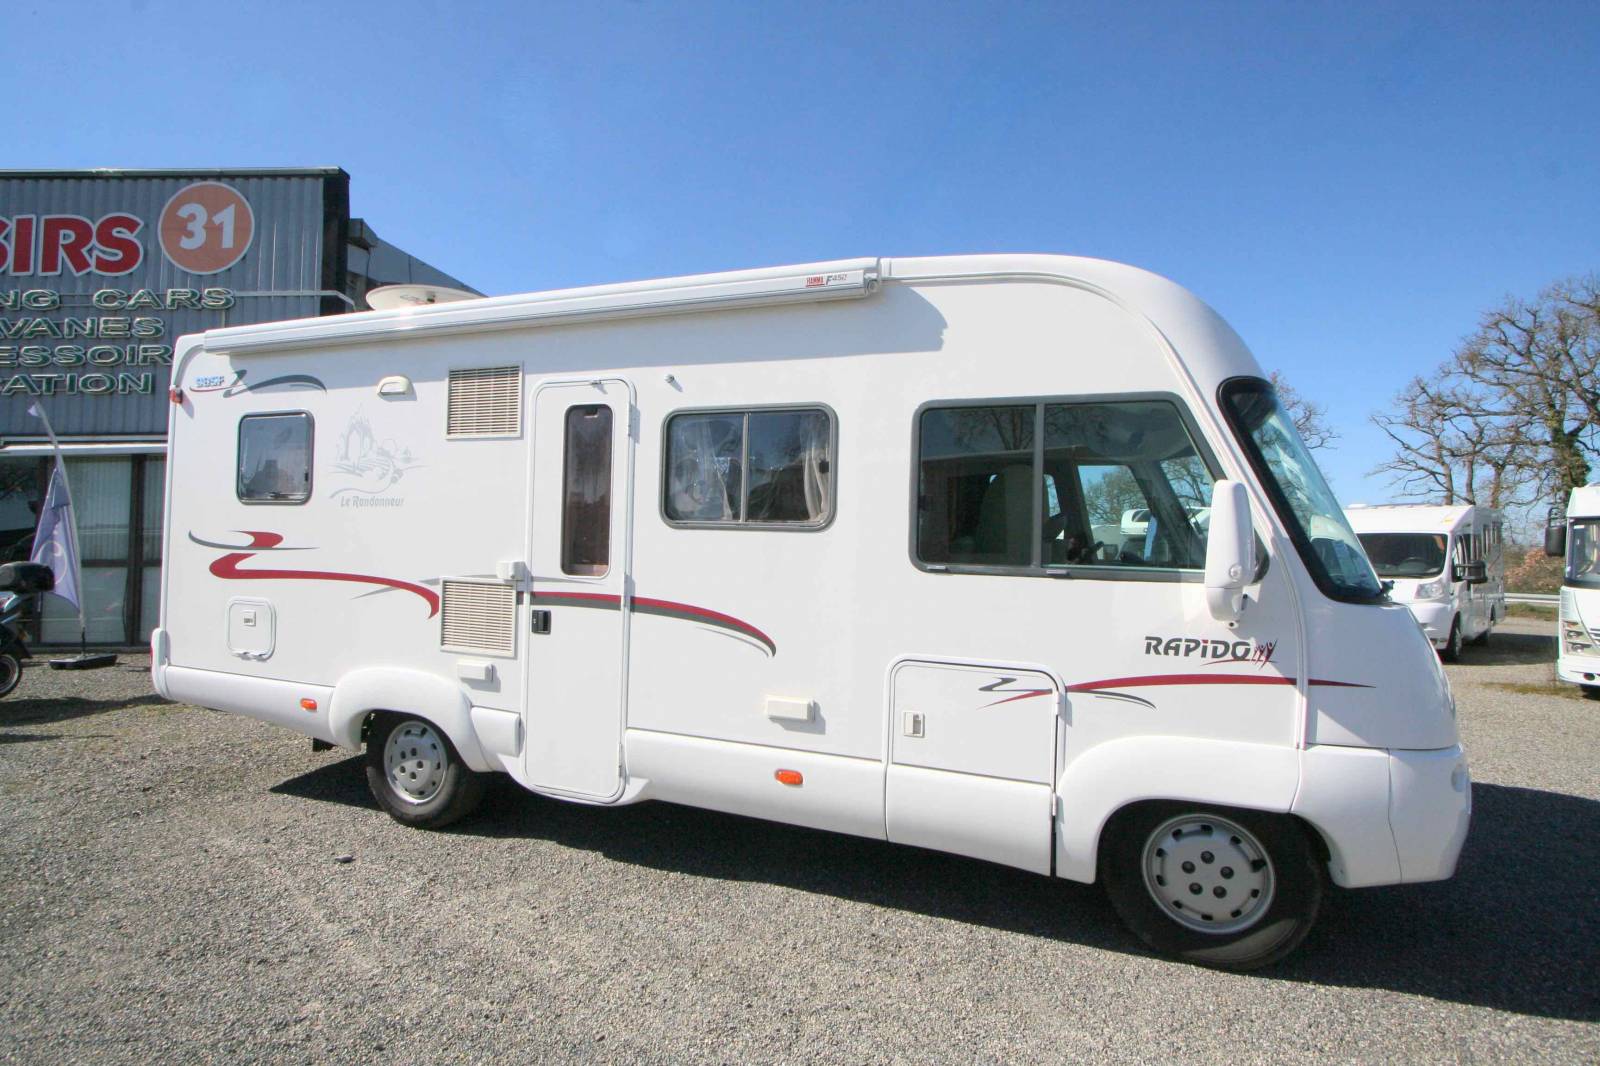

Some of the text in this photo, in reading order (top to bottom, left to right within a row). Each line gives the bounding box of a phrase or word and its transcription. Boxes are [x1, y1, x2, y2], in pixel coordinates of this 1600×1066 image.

[0, 203, 236, 276] IRS 31
[93, 288, 235, 310] CARS
[0, 317, 164, 338] VANES
[2, 373, 152, 395] ATION
[340, 496, 351, 507] Le
